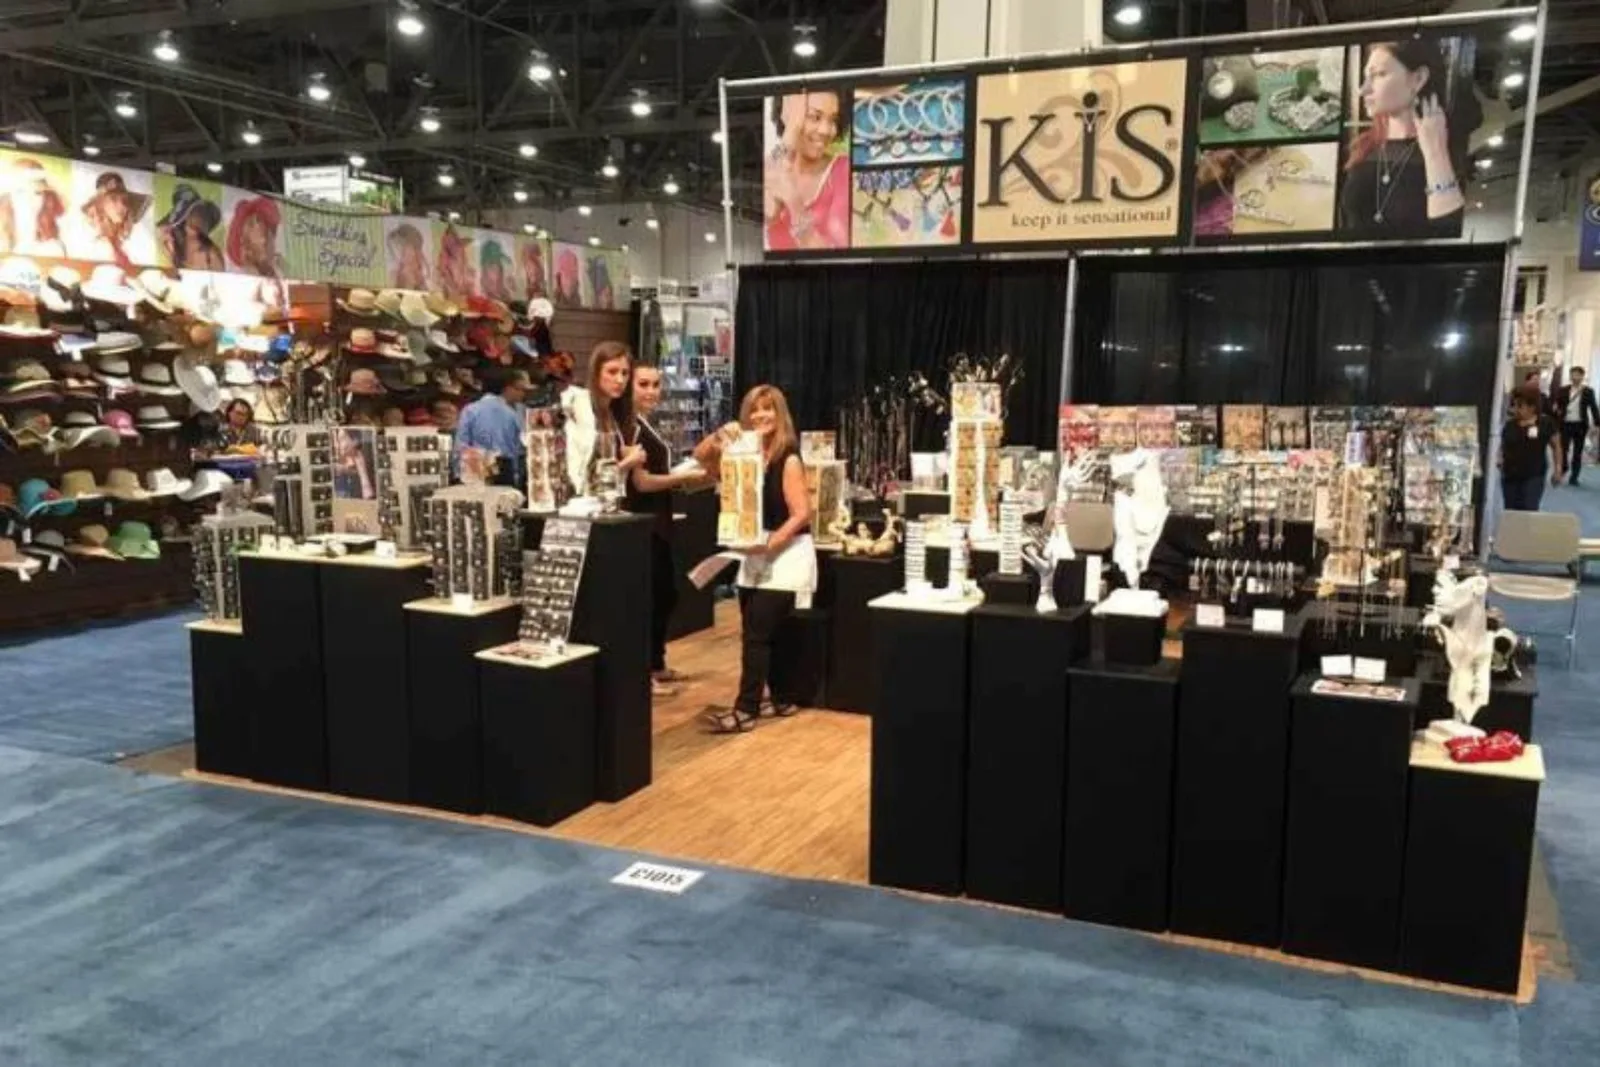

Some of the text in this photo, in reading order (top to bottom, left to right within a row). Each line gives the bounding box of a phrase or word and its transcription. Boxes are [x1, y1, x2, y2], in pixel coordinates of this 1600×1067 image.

[291, 211, 369, 246] Something
[1011, 206, 1172, 229] keep it sensational
[319, 241, 377, 276] Special
